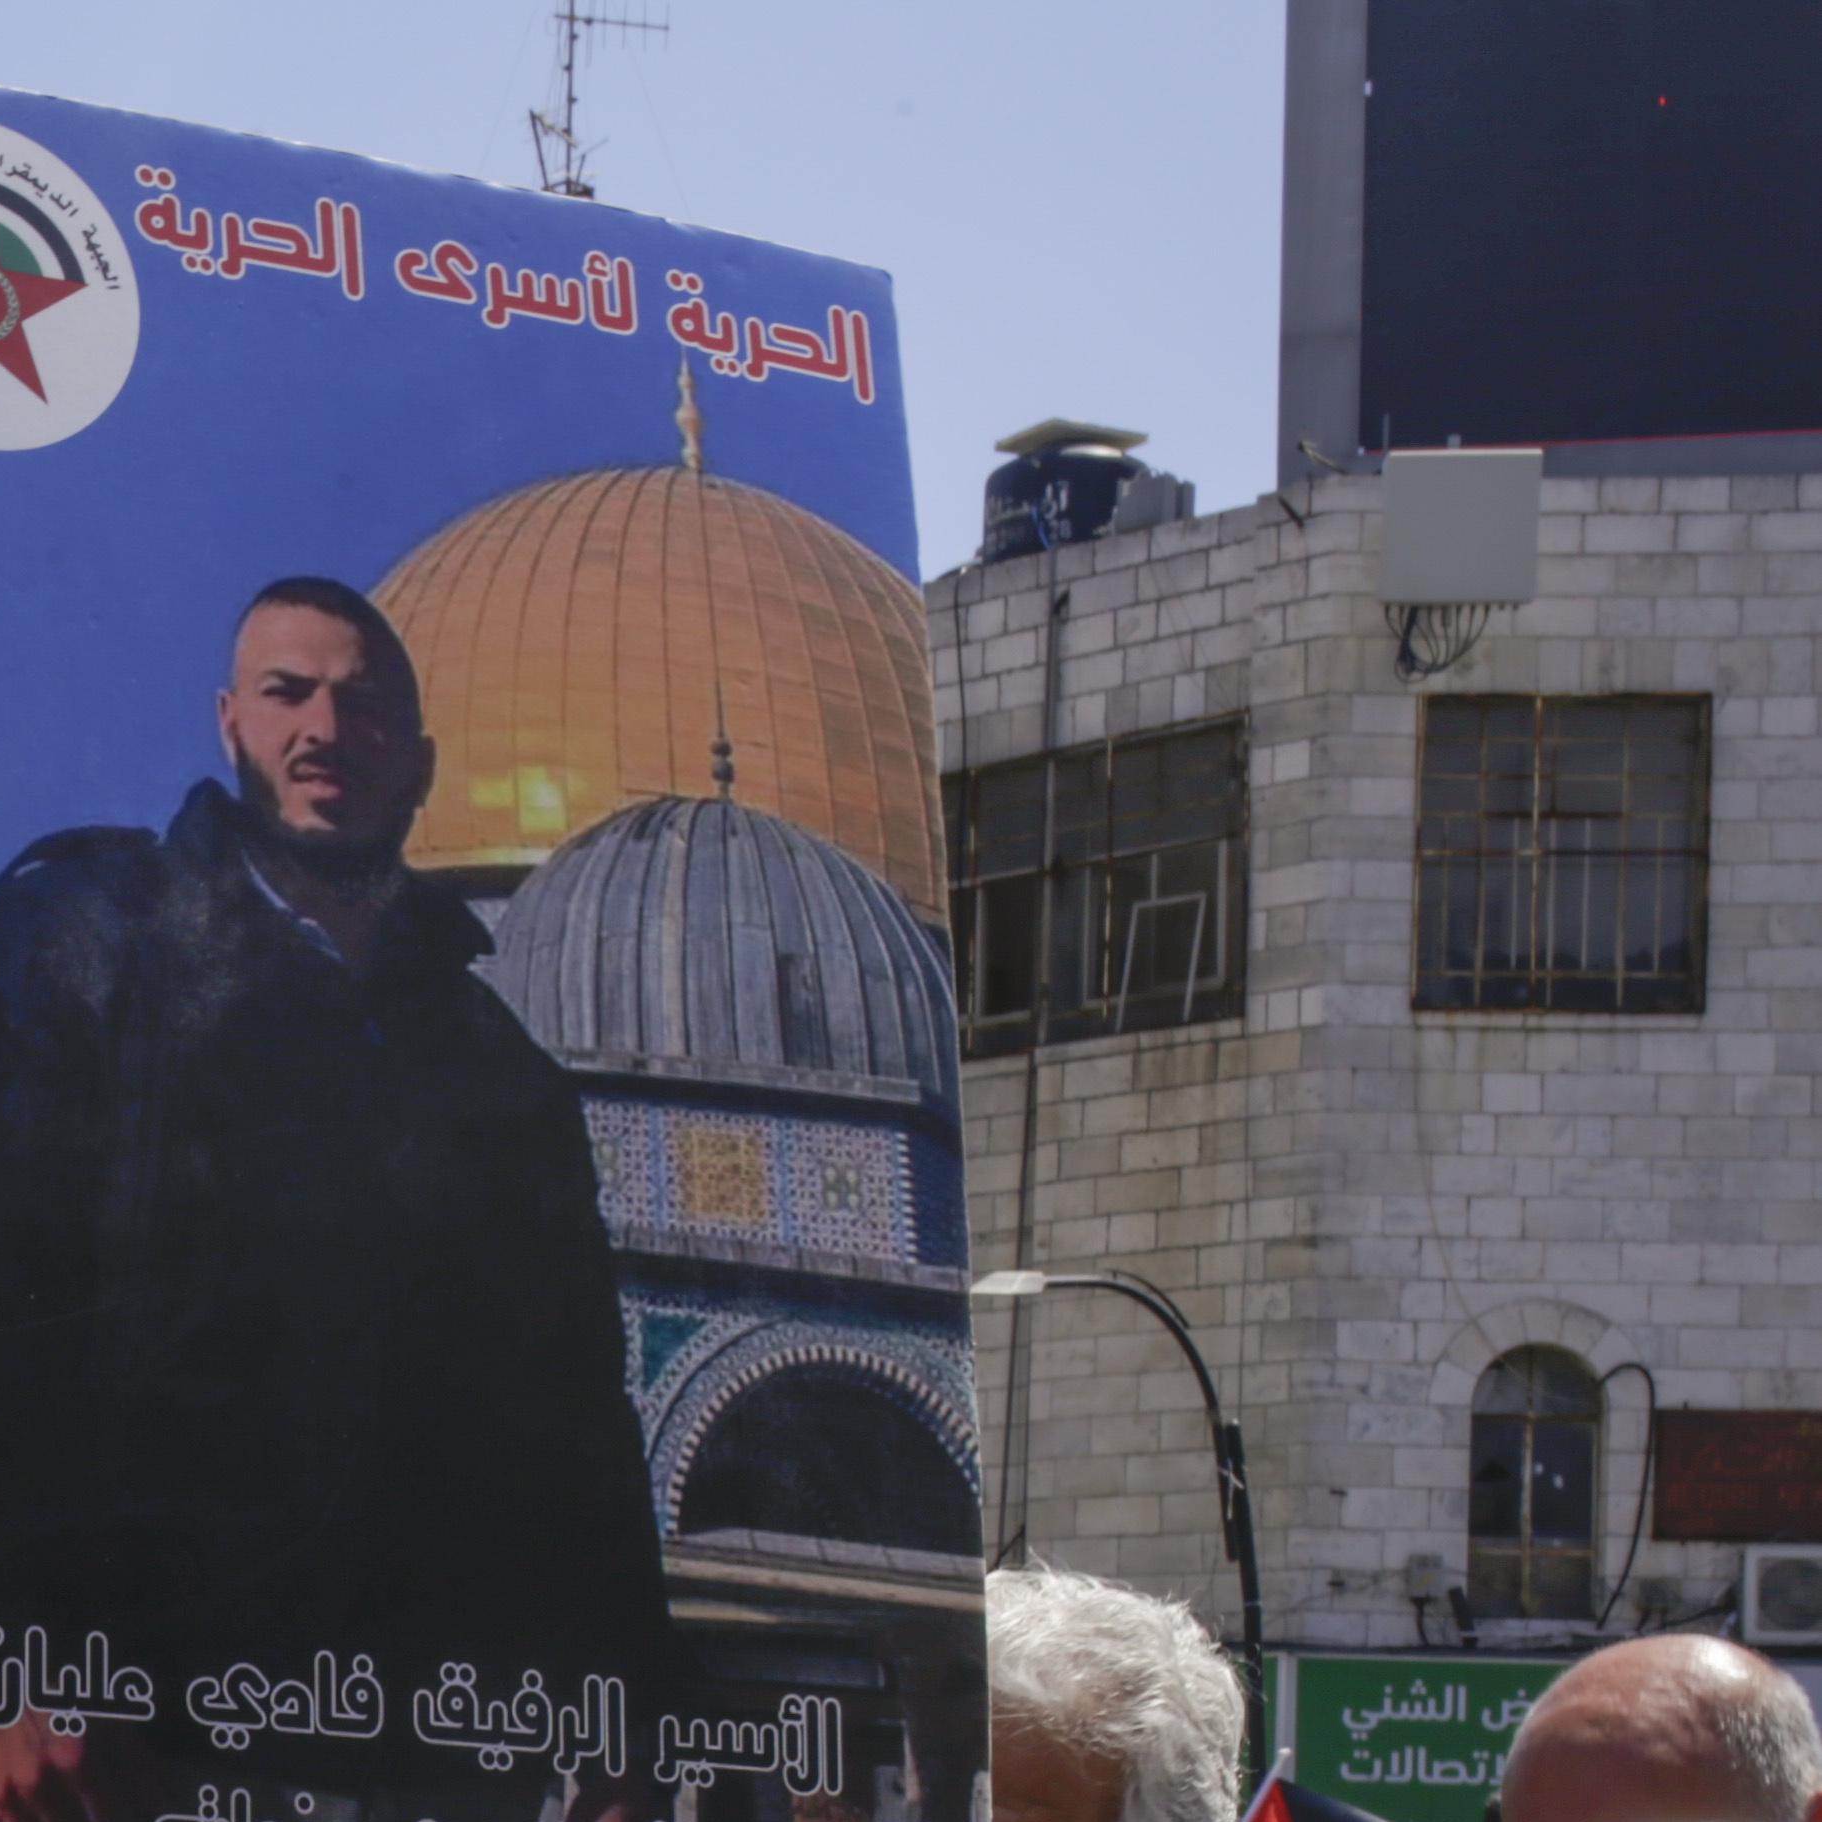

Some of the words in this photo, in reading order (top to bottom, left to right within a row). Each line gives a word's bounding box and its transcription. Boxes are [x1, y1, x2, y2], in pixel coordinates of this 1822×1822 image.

[82, 223, 121, 291] الجبهة
[135, 164, 365, 302] الحرية
[394, 239, 638, 335] لأسرى
[665, 270, 874, 405] الحرية
[186, 1649, 385, 1750] فادي
[413, 1660, 627, 1778] الرفيق
[653, 1693, 844, 1796] الأسير
[1342, 1678, 1467, 1742] الشني
